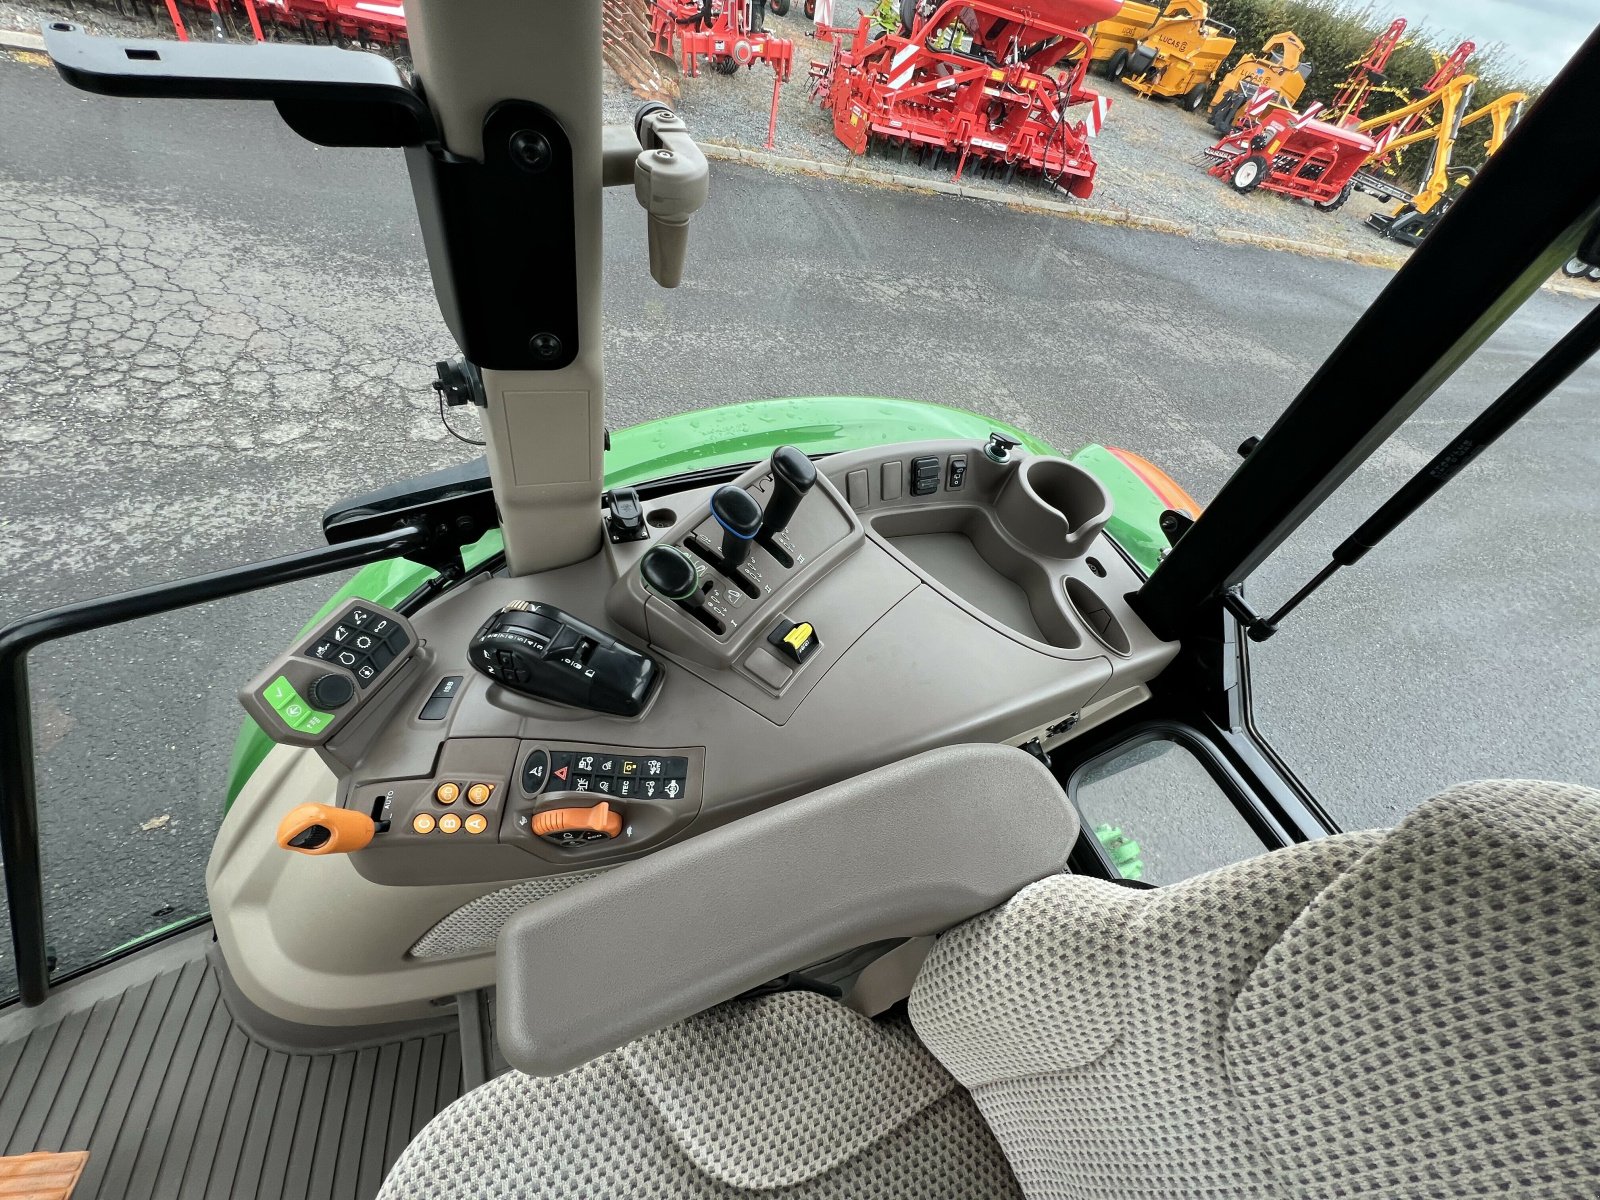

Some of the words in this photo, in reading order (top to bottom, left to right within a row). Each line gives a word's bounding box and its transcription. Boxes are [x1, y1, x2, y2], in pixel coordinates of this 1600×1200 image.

[1158, 34, 1180, 48] LUCAS
[1240, 69, 1262, 83] LUCAS
[384, 790, 394, 810] AUTO
[418, 819, 431, 829] C
[445, 819, 456, 829] B
[468, 819, 481, 829] A
